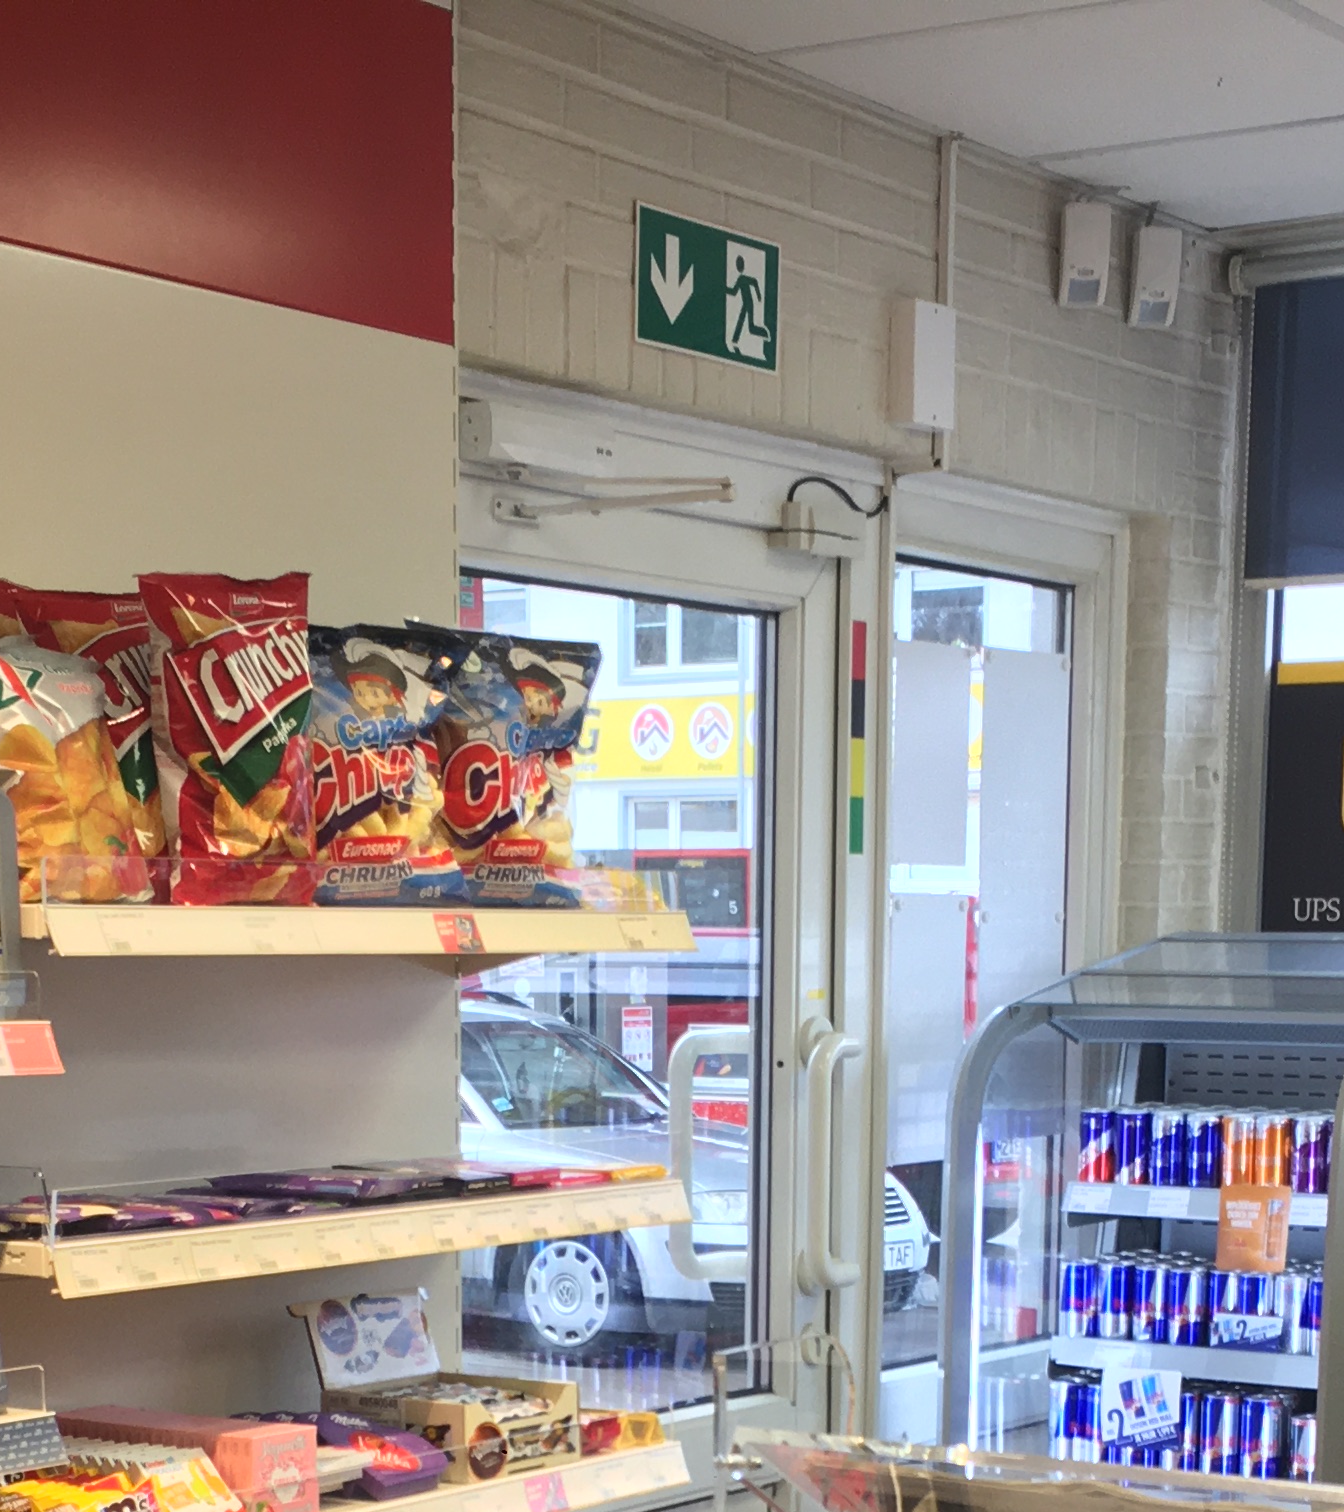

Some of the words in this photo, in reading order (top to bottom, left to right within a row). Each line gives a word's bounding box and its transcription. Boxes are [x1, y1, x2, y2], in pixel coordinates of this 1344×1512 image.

[325, 863, 413, 886] CHRUPKI
[473, 865, 545, 883] CHRUPKI
[1293, 897, 1341, 923] UPS
